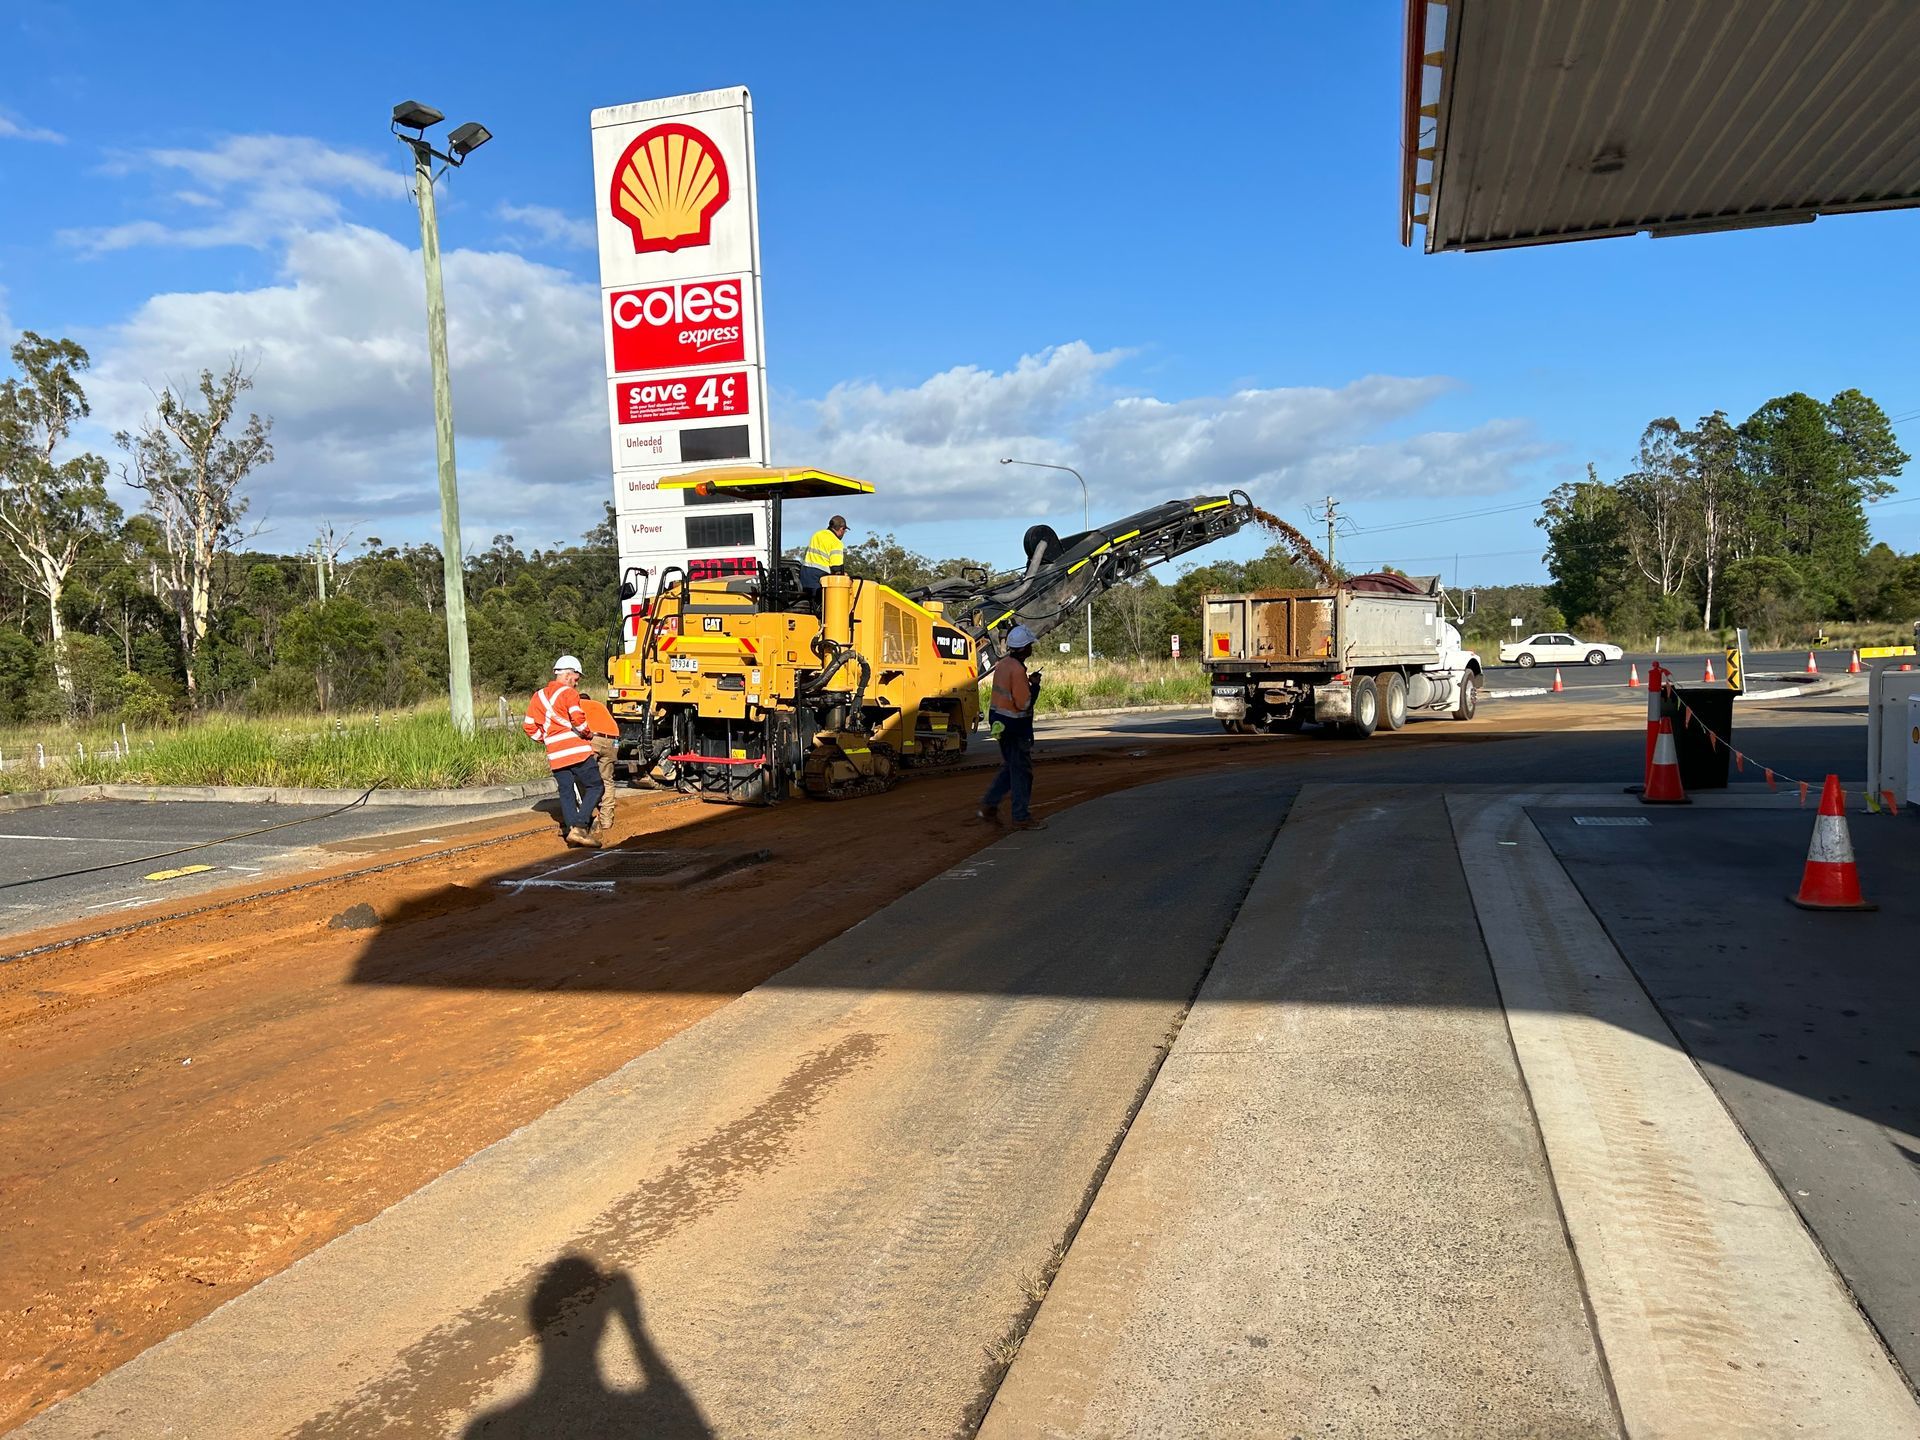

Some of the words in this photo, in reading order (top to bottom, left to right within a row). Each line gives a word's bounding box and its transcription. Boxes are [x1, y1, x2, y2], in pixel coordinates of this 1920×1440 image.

[613, 284, 739, 329] coles
[678, 326, 739, 348] express
[629, 383, 687, 404] save
[626, 435, 662, 448] Unleaded
[653, 446, 663, 454] E10
[628, 479, 659, 492] Unlead
[631, 523, 663, 534] V-Power
[704, 618, 721, 631] CAT
[951, 637, 966, 655] CAT
